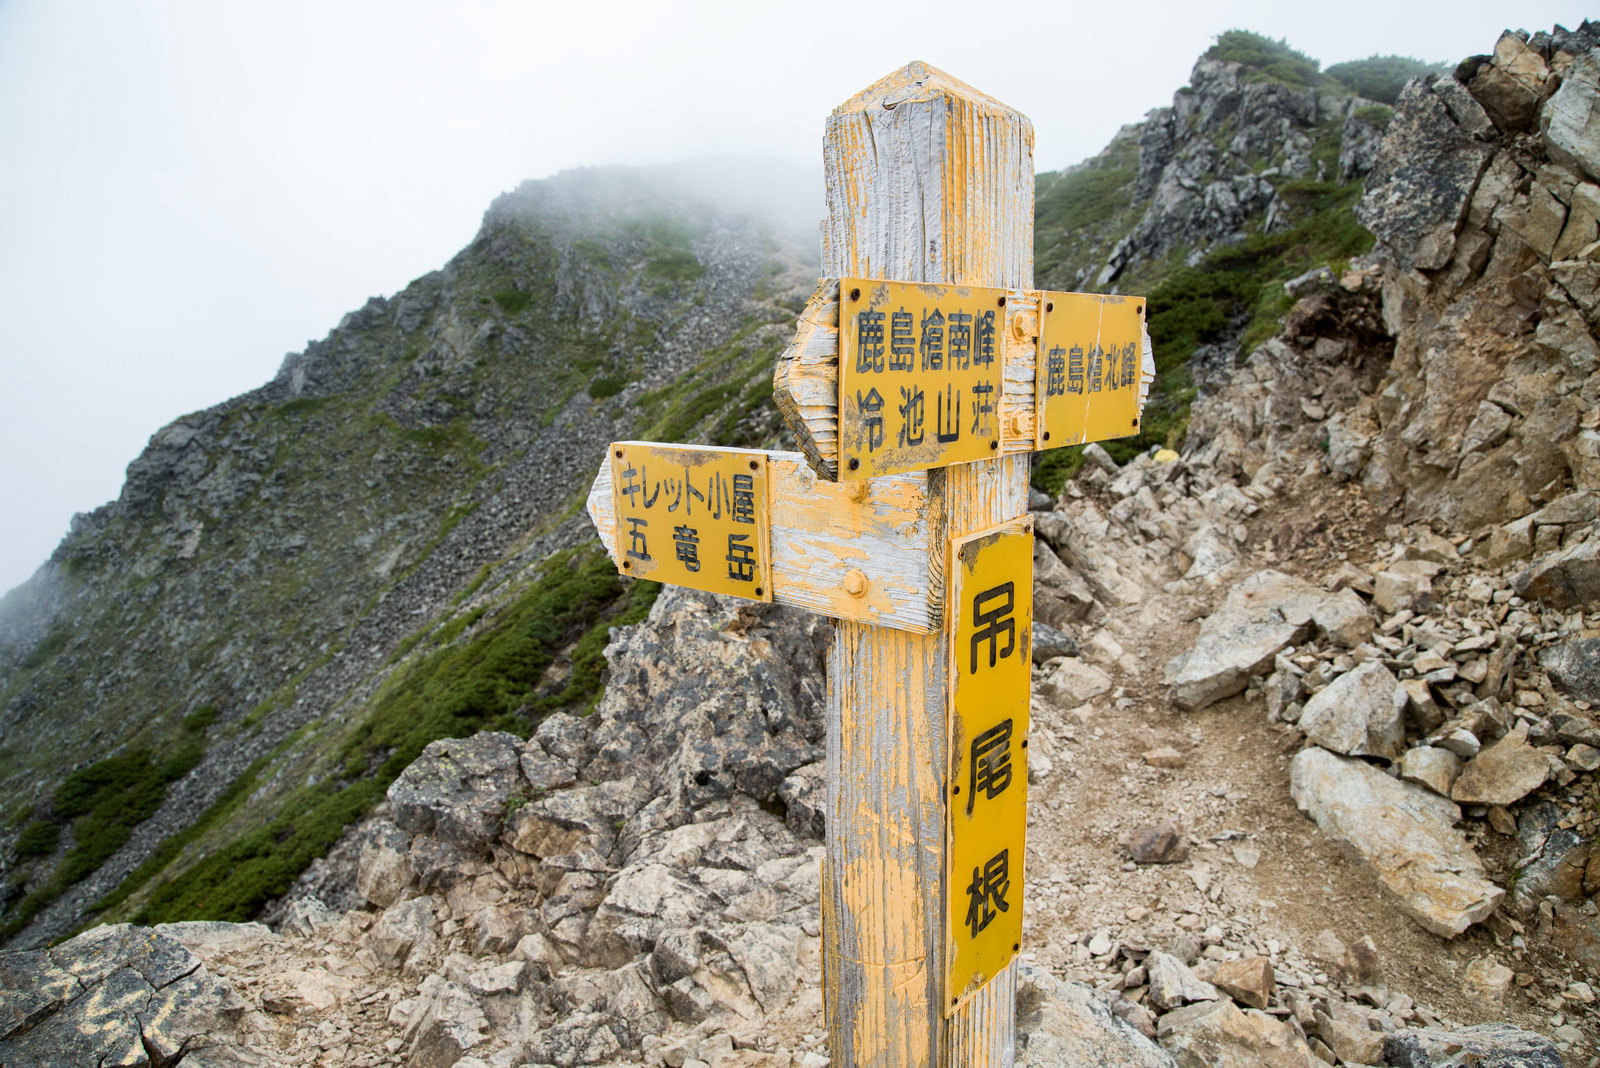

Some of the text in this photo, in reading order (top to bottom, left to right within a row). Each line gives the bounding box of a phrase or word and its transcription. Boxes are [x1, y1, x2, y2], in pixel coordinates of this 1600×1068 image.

[856, 306, 996, 373] 鹿島槍南峰
[1046, 342, 1137, 397] 鹿島槍北峰
[856, 380, 994, 453] 冷池山荘
[622, 461, 755, 525] キレット小屋
[626, 517, 756, 582] 五竜岳
[964, 580, 1015, 939] 吊尾根
